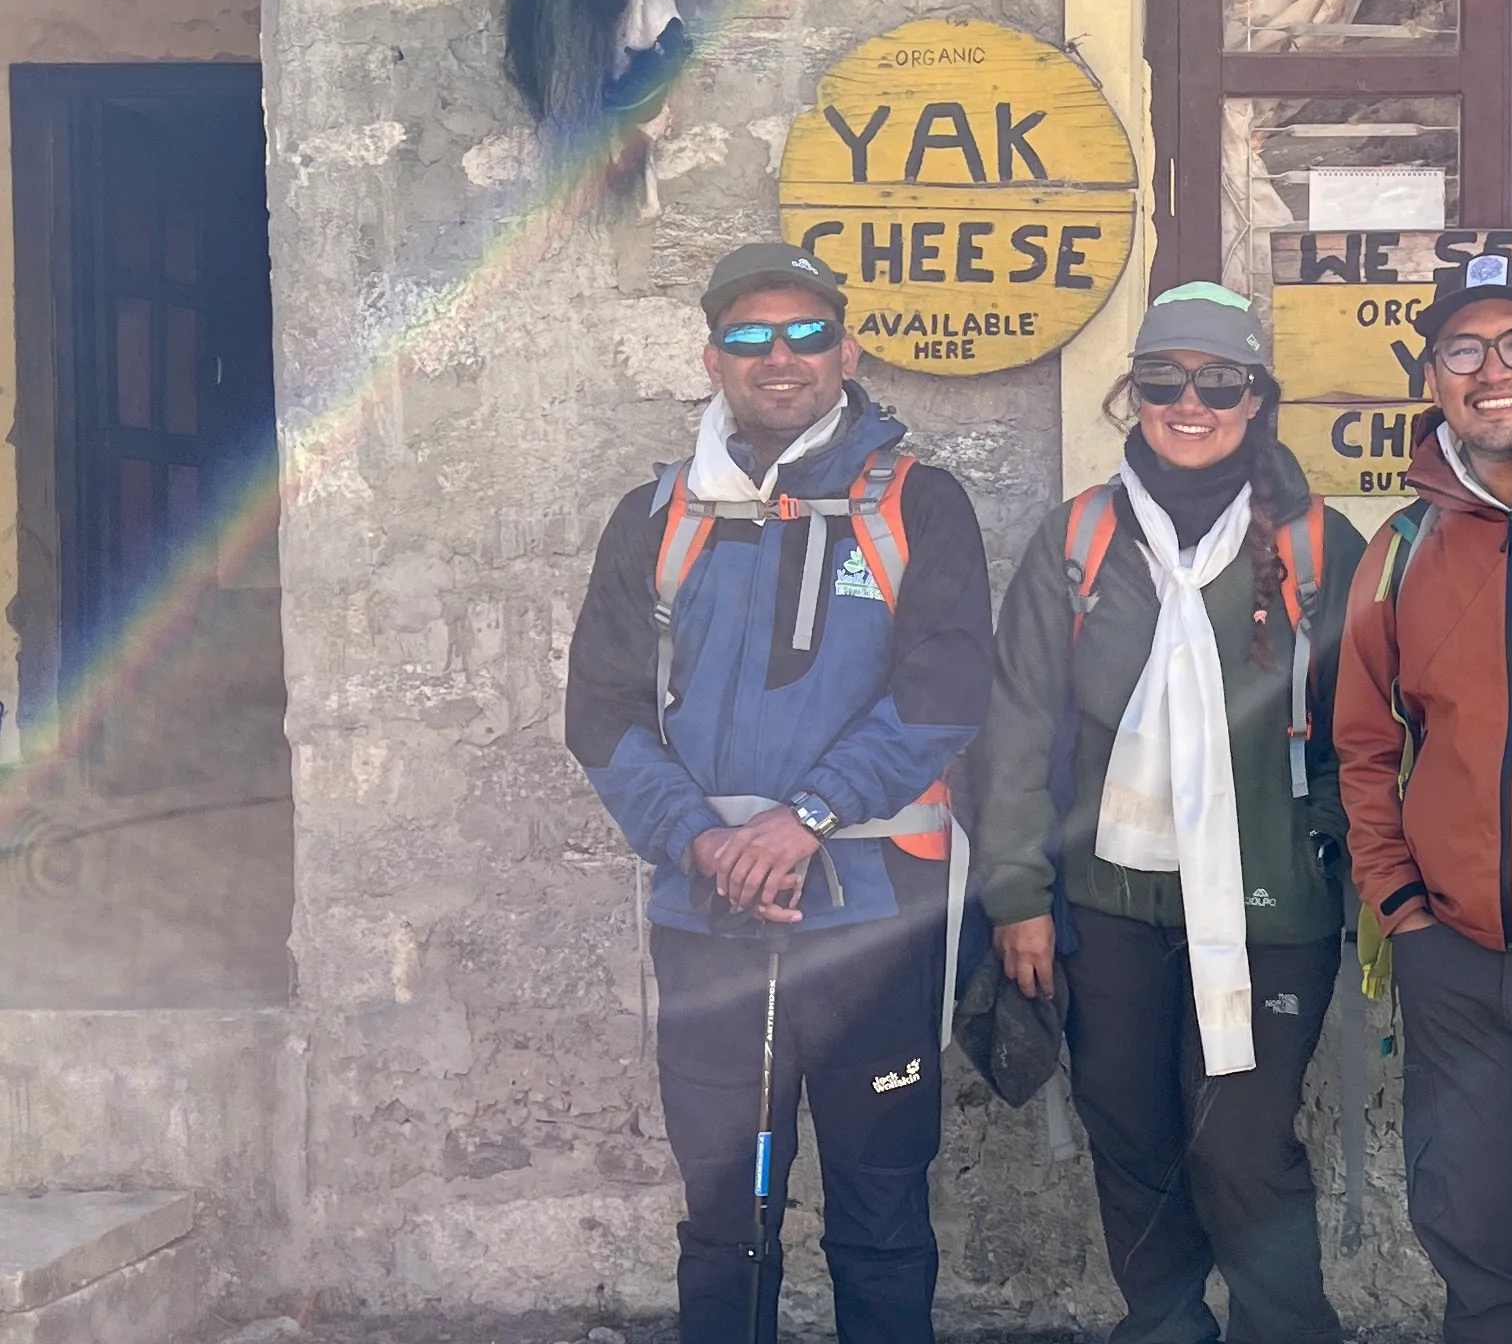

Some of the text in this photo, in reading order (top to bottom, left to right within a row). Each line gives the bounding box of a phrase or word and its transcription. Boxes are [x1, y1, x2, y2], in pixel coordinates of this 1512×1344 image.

[895, 46, 986, 68] ORGANIC
[823, 102, 1048, 183] YAK
[801, 221, 1101, 289] CHEESE
[1300, 232, 1401, 282] WE
[857, 313, 1038, 337] AVAILABLE
[913, 340, 976, 360] HERE
[872, 1073, 920, 1093] Wolfskin
[874, 1072, 898, 1084] Jack
